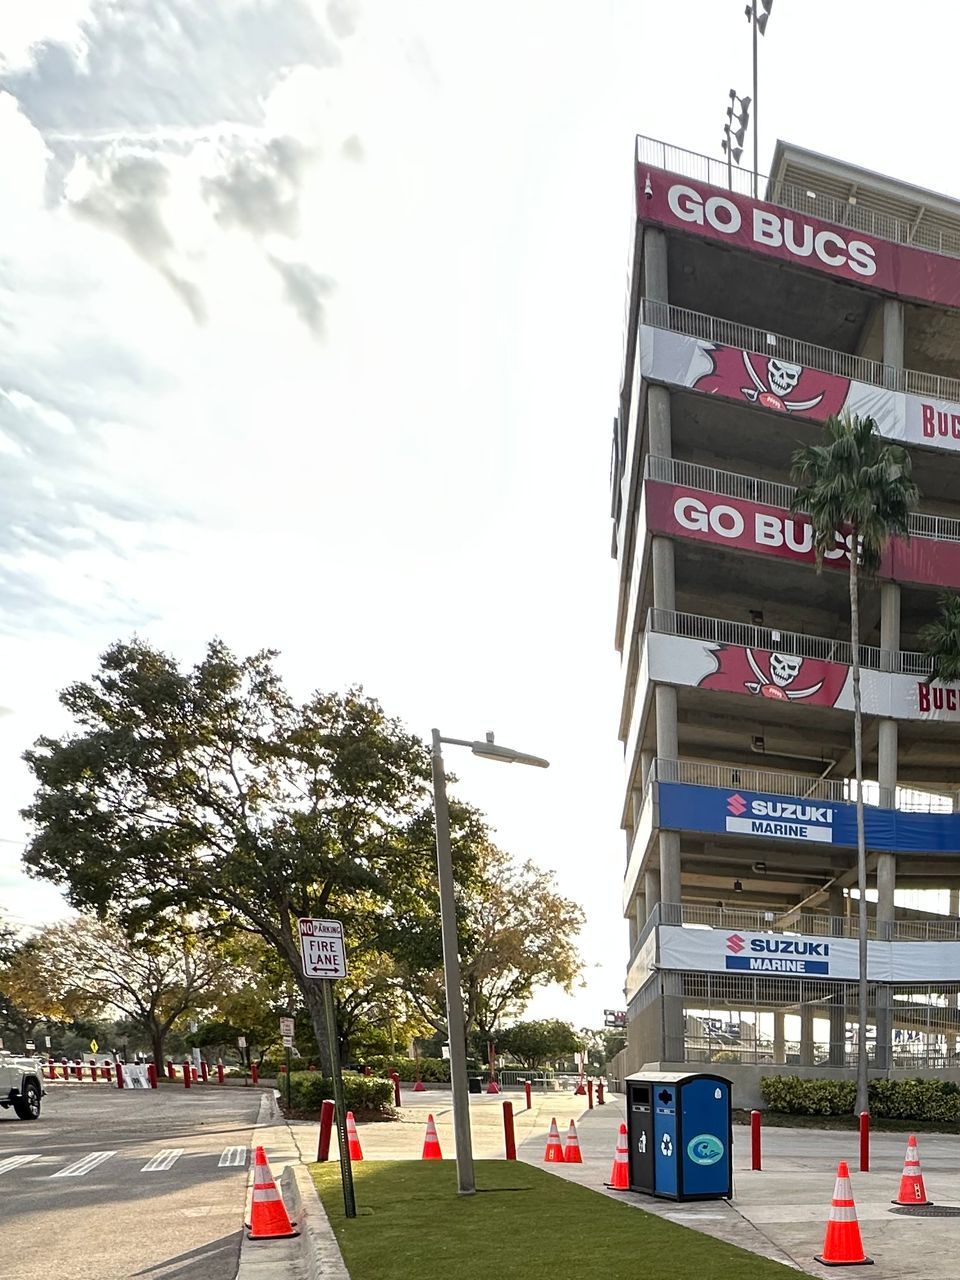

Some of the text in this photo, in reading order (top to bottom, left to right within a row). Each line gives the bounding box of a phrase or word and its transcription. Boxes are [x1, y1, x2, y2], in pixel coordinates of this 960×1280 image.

[668, 184, 877, 276] GO BUCS
[673, 497, 744, 538] GO
[751, 799, 833, 824] SUZUKI
[751, 821, 808, 839] MARINE
[300, 922, 341, 935] NO PARKING
[310, 941, 337, 953] FIRE
[750, 939, 829, 957] SUZUKI
[309, 954, 340, 966] LANE
[749, 958, 805, 973] MARINE
